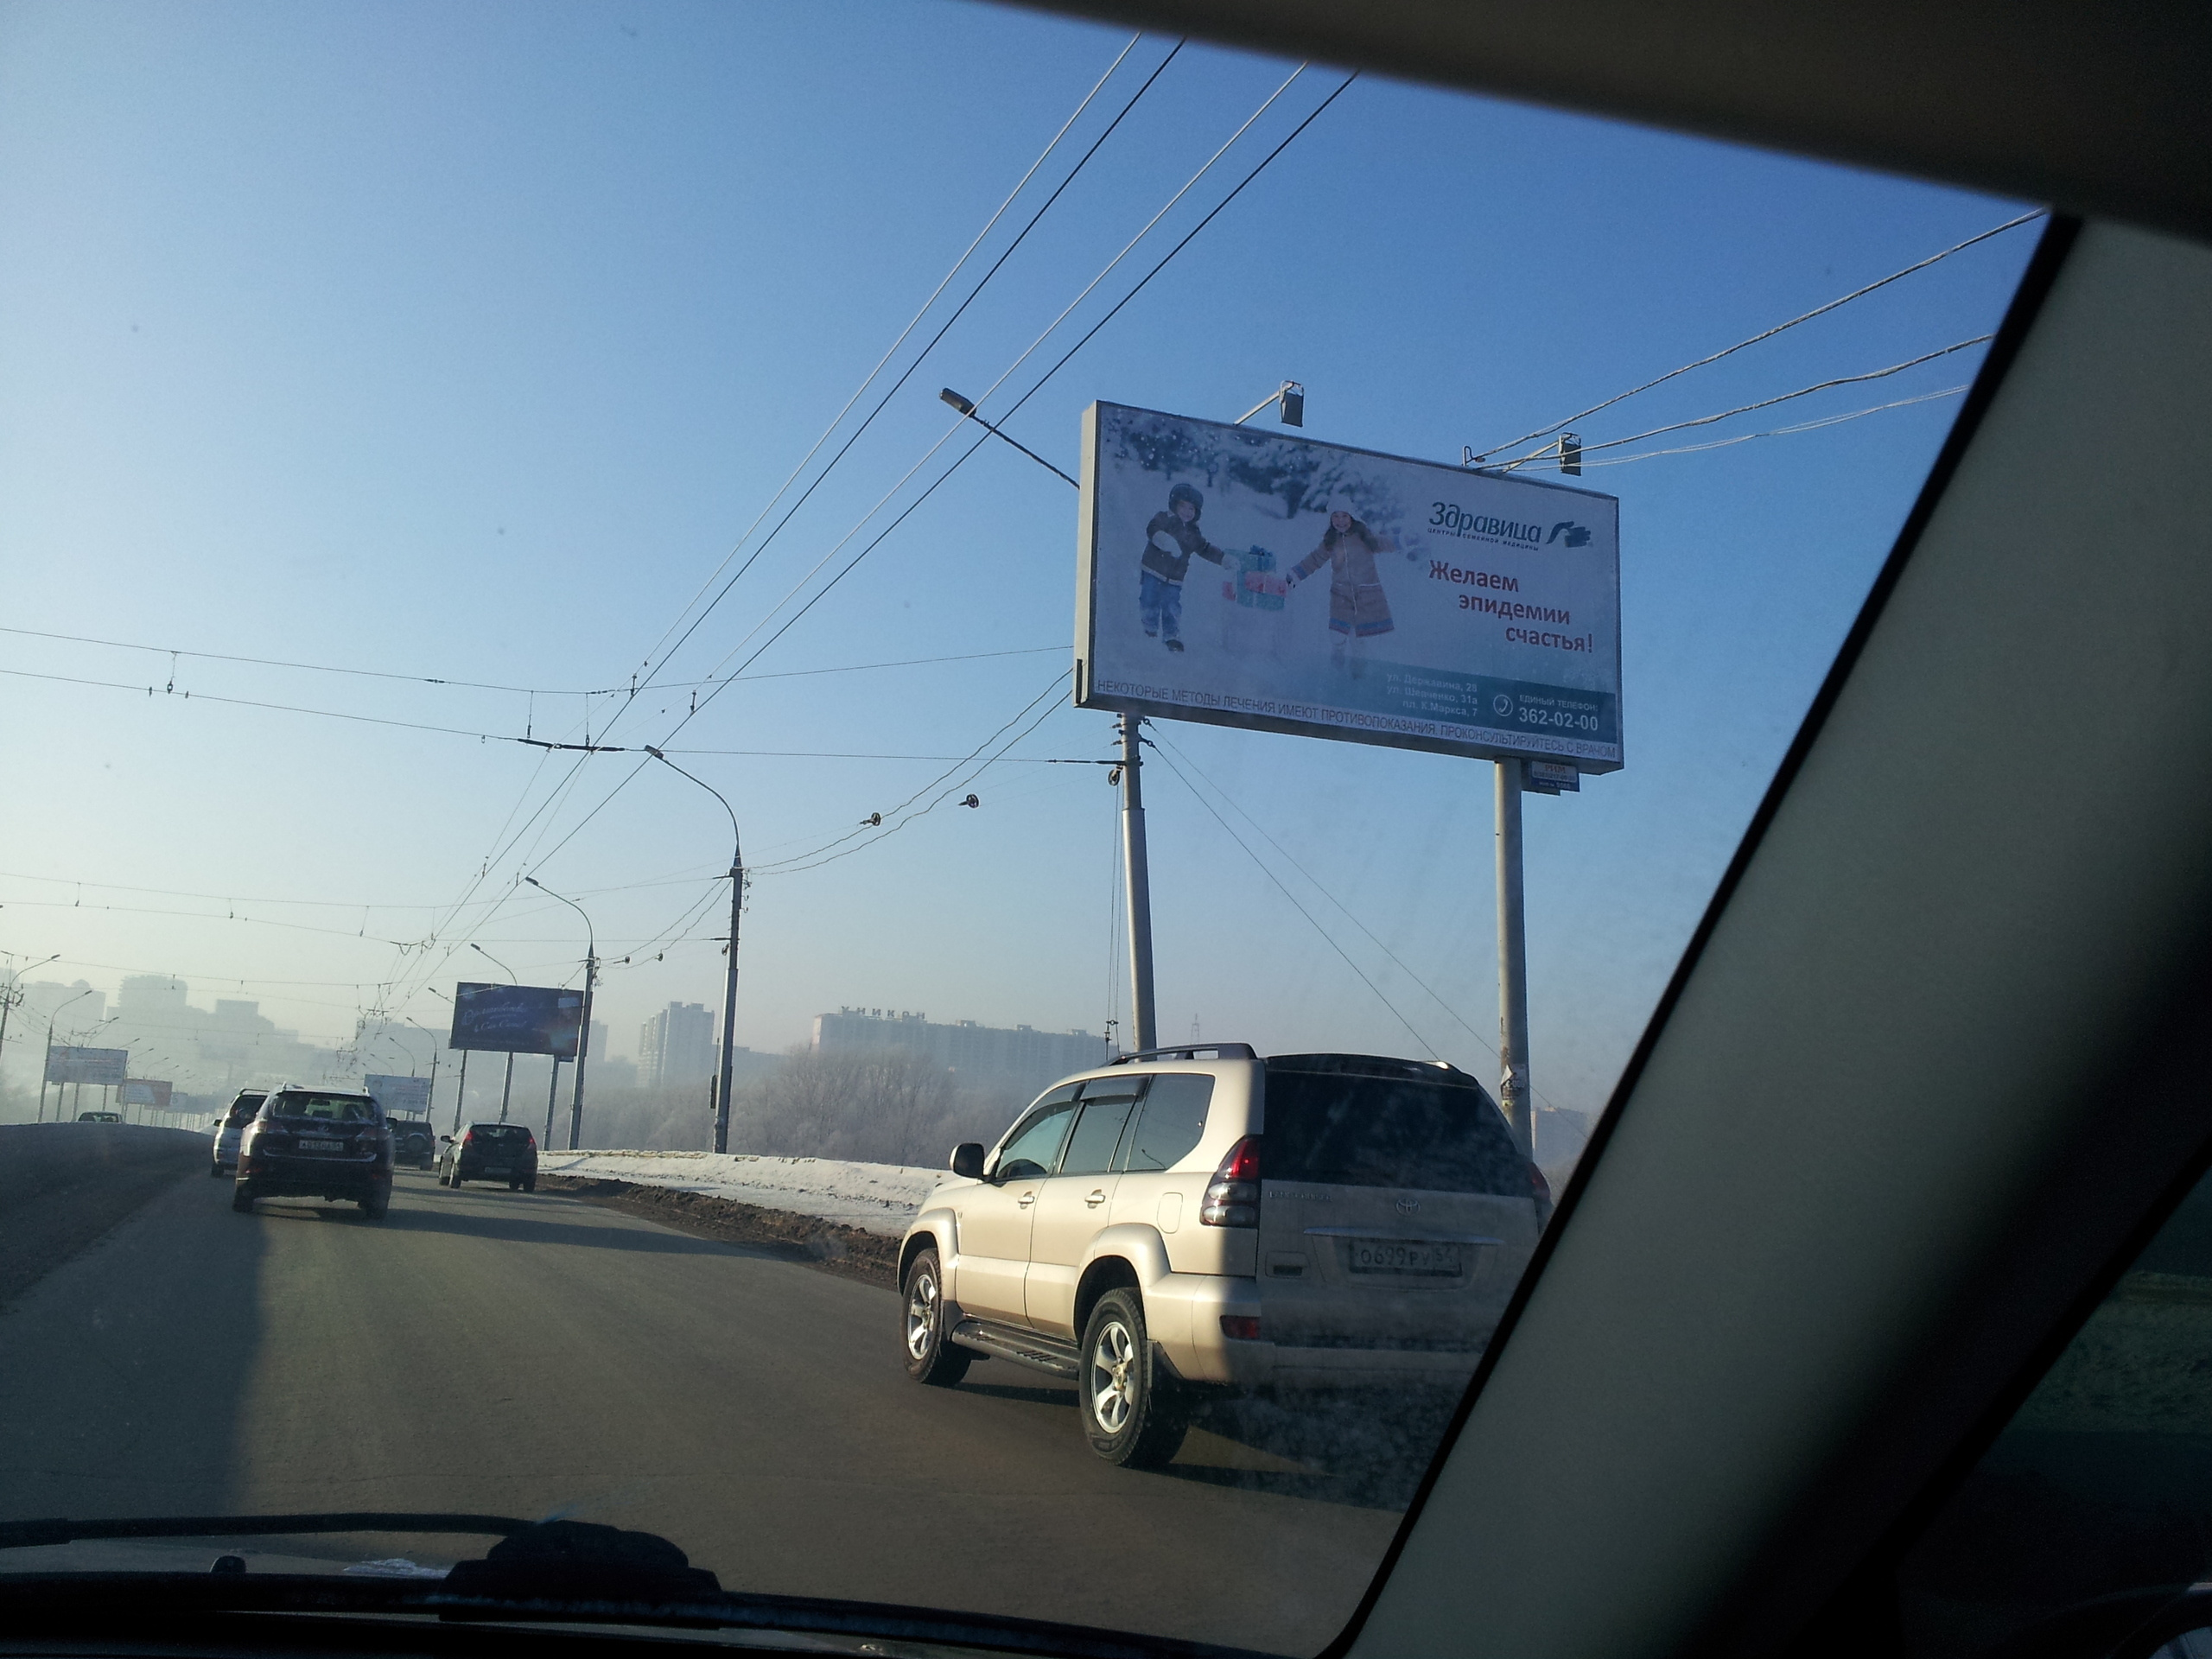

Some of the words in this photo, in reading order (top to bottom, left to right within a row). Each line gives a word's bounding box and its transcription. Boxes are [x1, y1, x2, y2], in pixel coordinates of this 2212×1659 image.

[1429, 502, 1541, 543] Здравица
[1427, 527, 1456, 537] ЦЕНТРЫ
[1462, 533, 1499, 544] СЕМЕЙНОЙ
[1503, 541, 1539, 551] МЕДИЦИНЫ
[1428, 559, 1519, 592] Желаем
[1459, 594, 1570, 625] эпидемии
[1505, 626, 1592, 653] счастья!
[1387, 673, 1402, 683] ул.
[1402, 700, 1419, 710] пл.
[1472, 708, 1478, 717] 7
[1461, 694, 1478, 705] 31а
[1519, 694, 1555, 707] ЕДИНЫЙ
[1558, 699, 1599, 712] ТЕЛЕФОН:
[1097, 679, 1169, 700] НЕКОТОРЫЕ
[1172, 689, 1220, 707] МЕТОДЫ
[1223, 695, 1276, 713] ЛЕЧЕНИЯ
[1278, 703, 1319, 720] ИМЕЮТ
[1440, 724, 1565, 753] ПРОКОНСУЛЬТИРУЙТЕСЬ
[1566, 741, 1573, 753] С
[1576, 742, 1616, 758] ВРАЧОМ
[1519, 707, 1599, 731] 362-02-00
